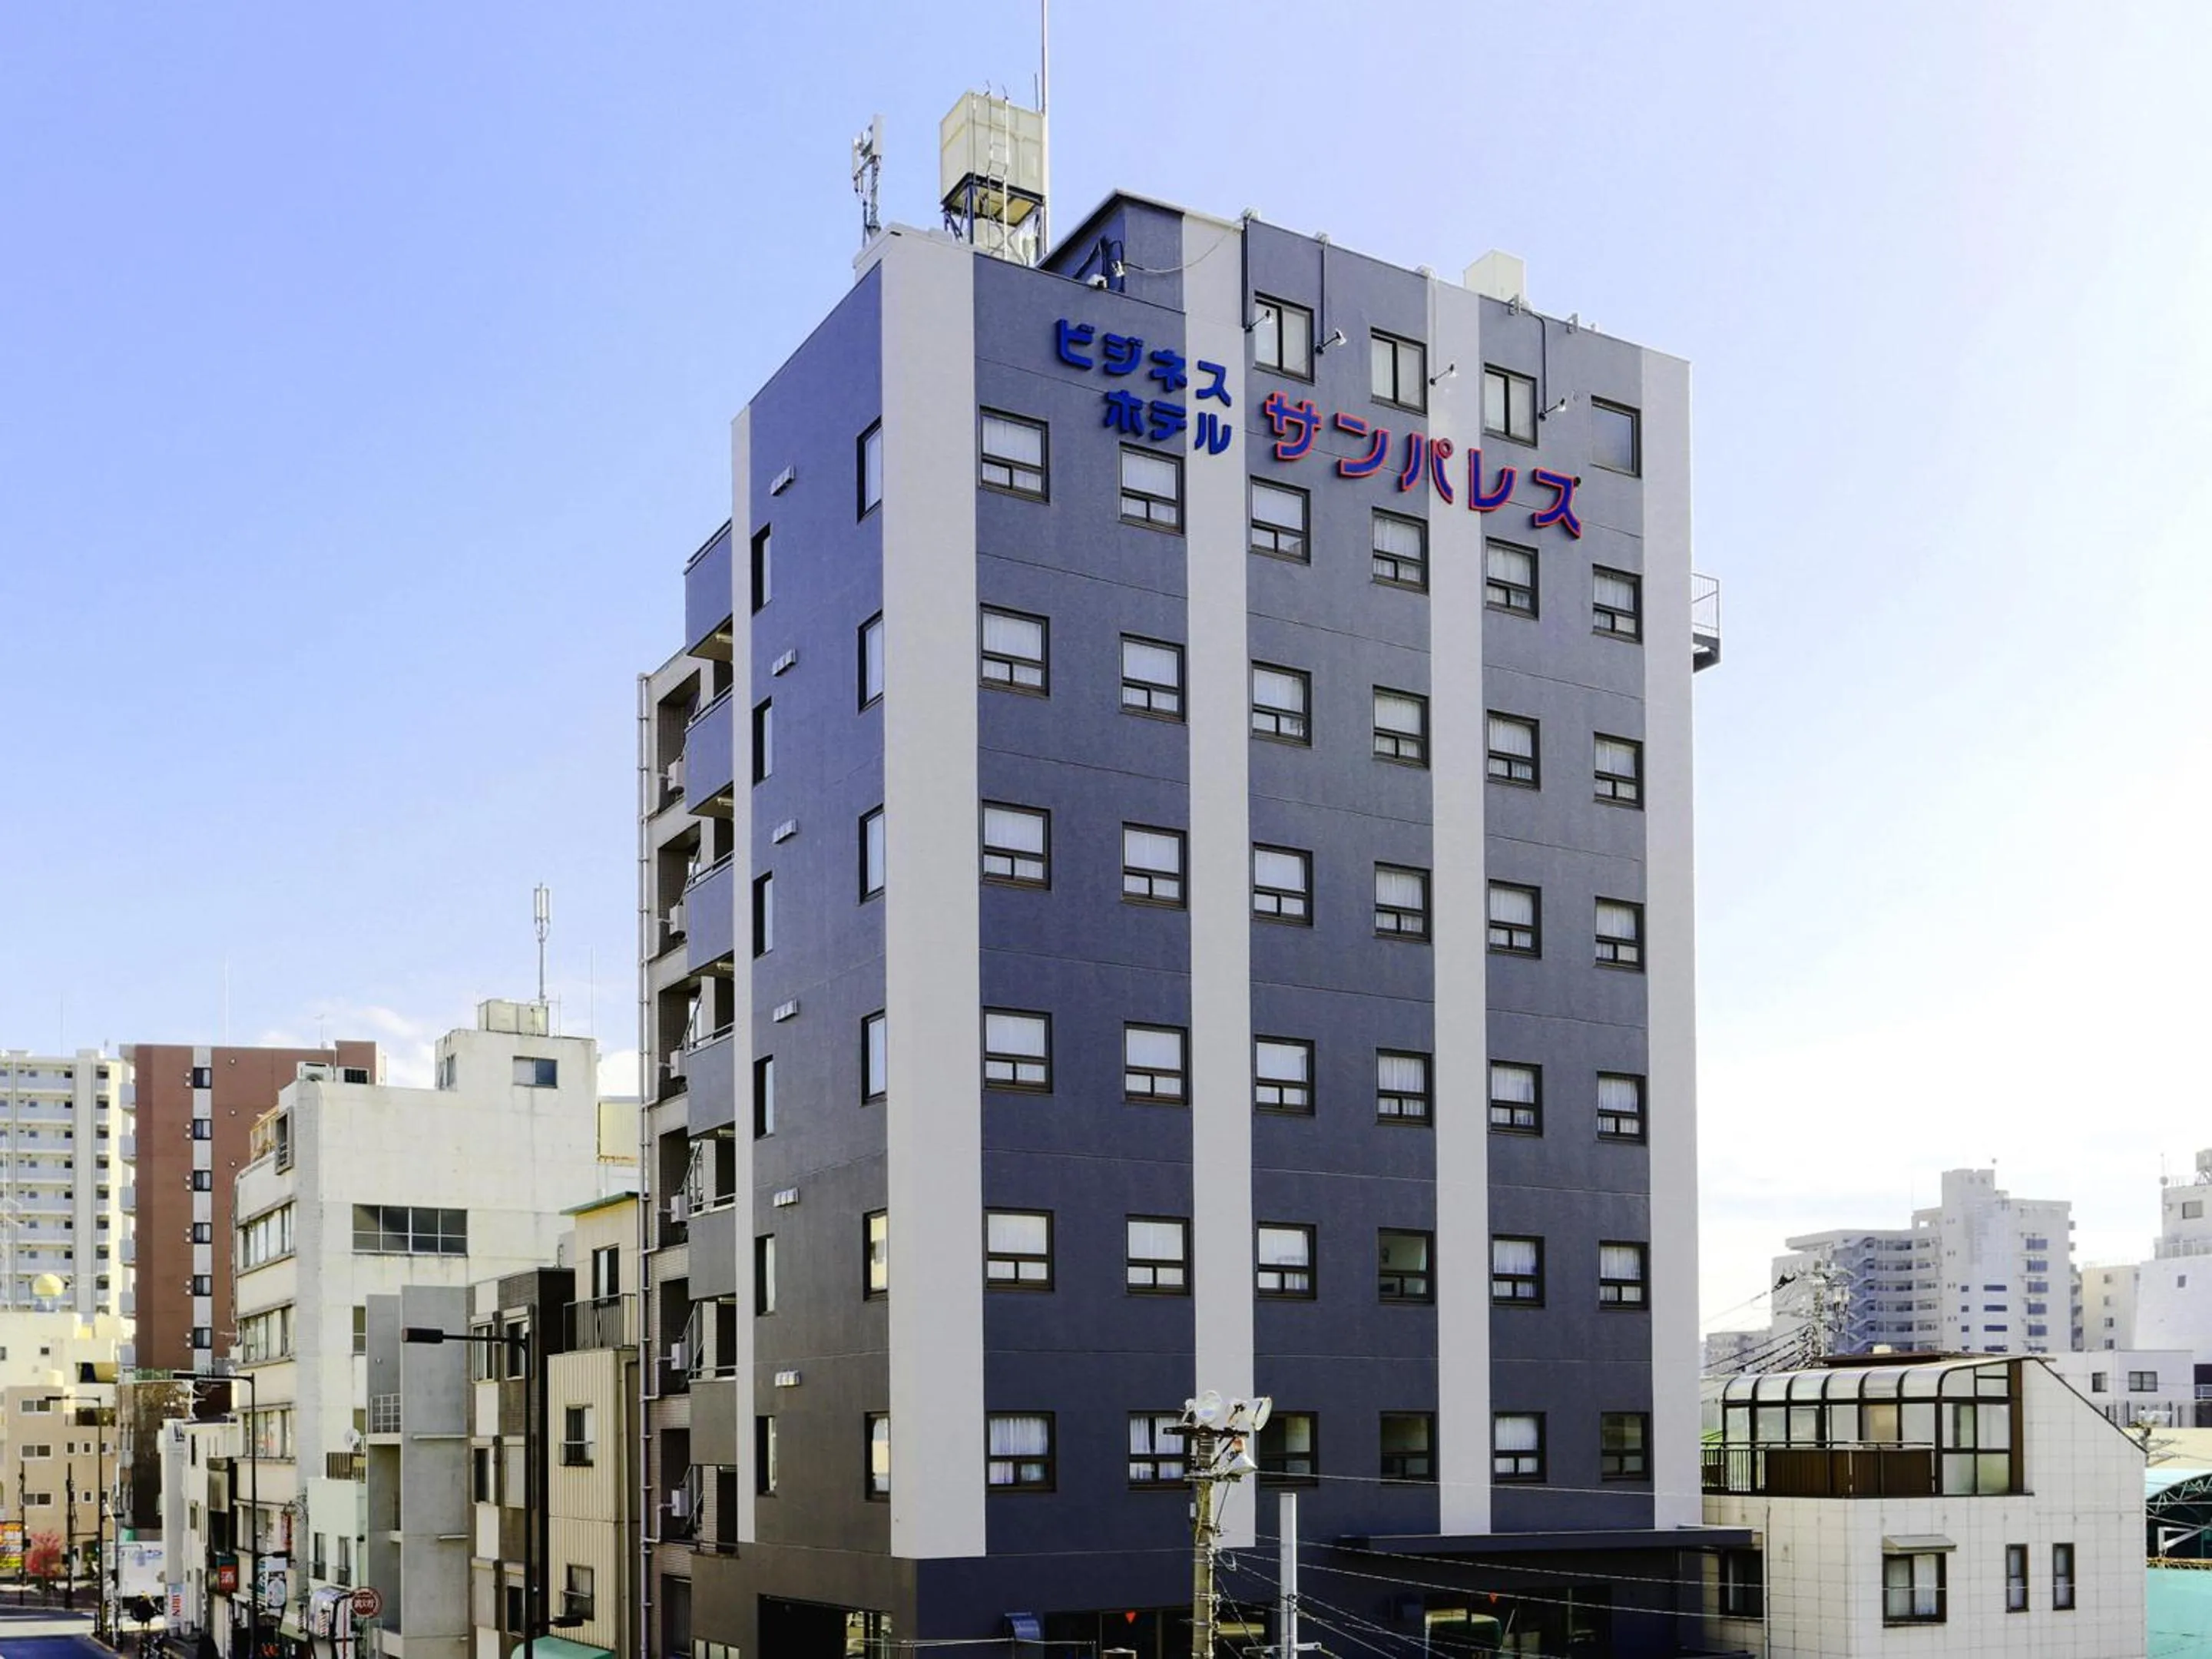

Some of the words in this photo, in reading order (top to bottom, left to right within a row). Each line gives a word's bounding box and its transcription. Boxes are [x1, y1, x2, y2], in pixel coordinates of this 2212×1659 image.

[1056, 319, 1231, 407] ビジネス
[1104, 389, 1232, 455] ホテル
[1265, 391, 1581, 538] サンパレス
